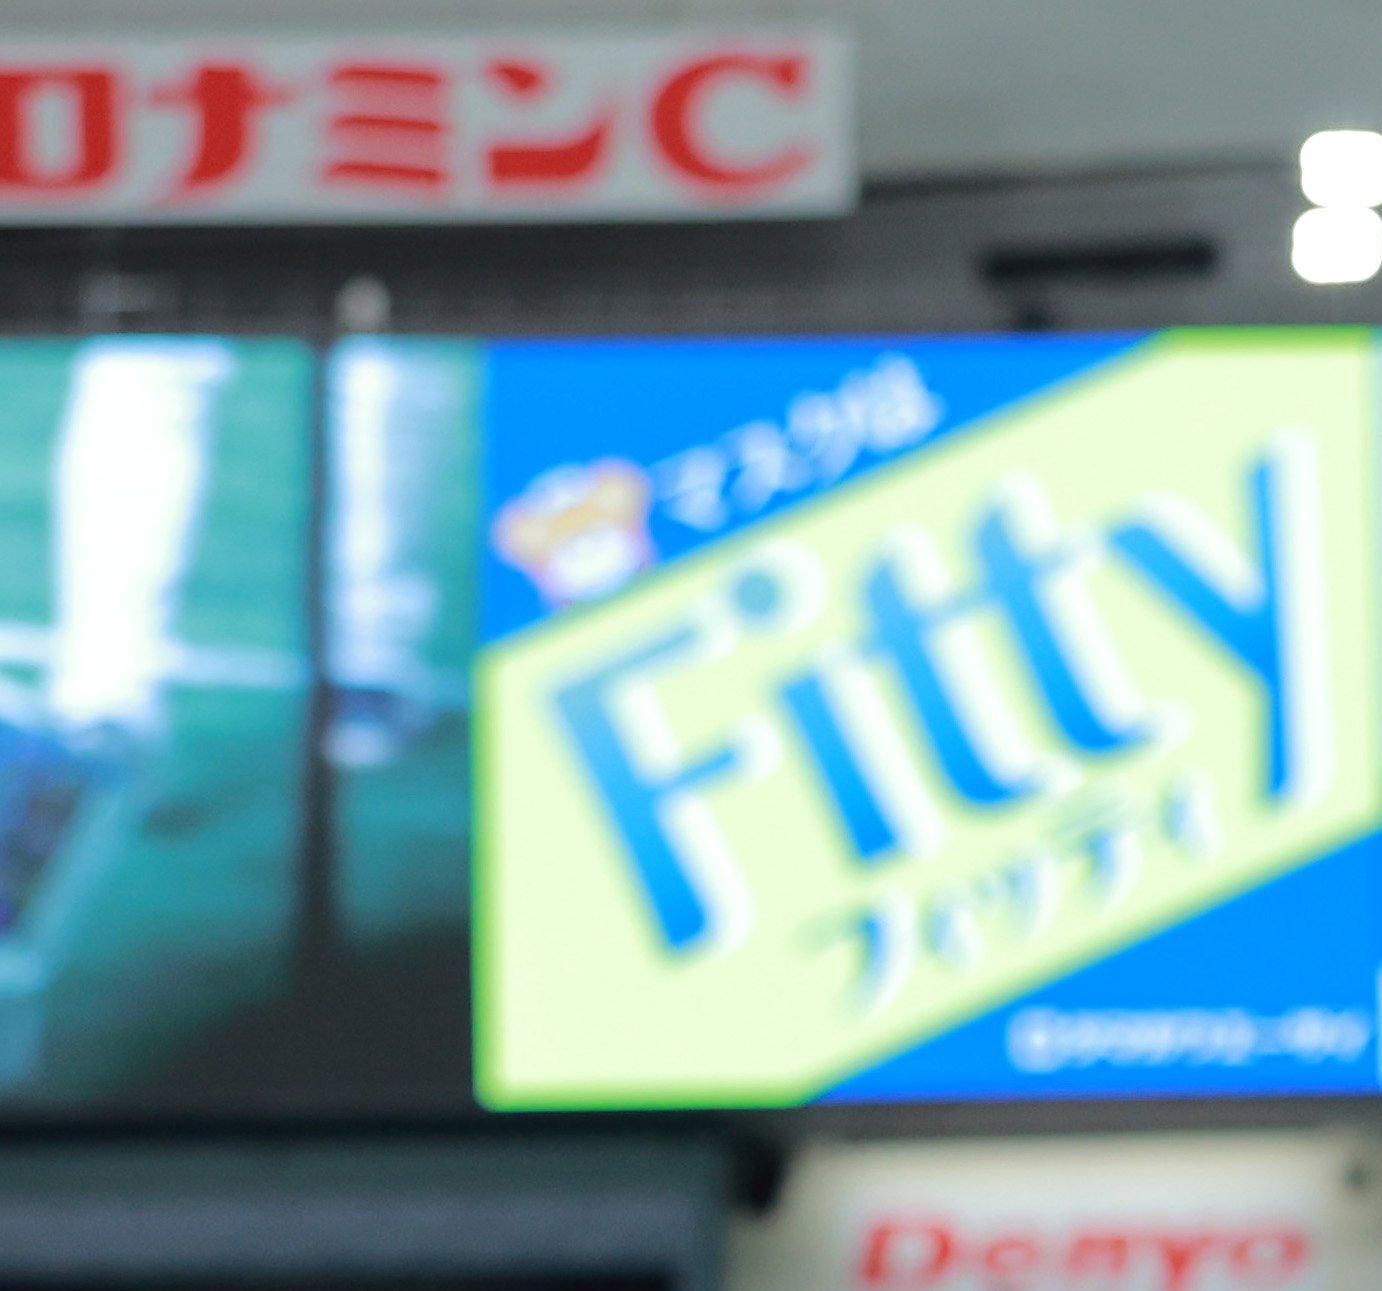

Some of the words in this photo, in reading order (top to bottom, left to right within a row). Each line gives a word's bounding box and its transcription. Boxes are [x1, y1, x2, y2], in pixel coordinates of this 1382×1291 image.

[0, 55, 810, 192] ロナミンC
[545, 432, 1330, 958] Fitty
